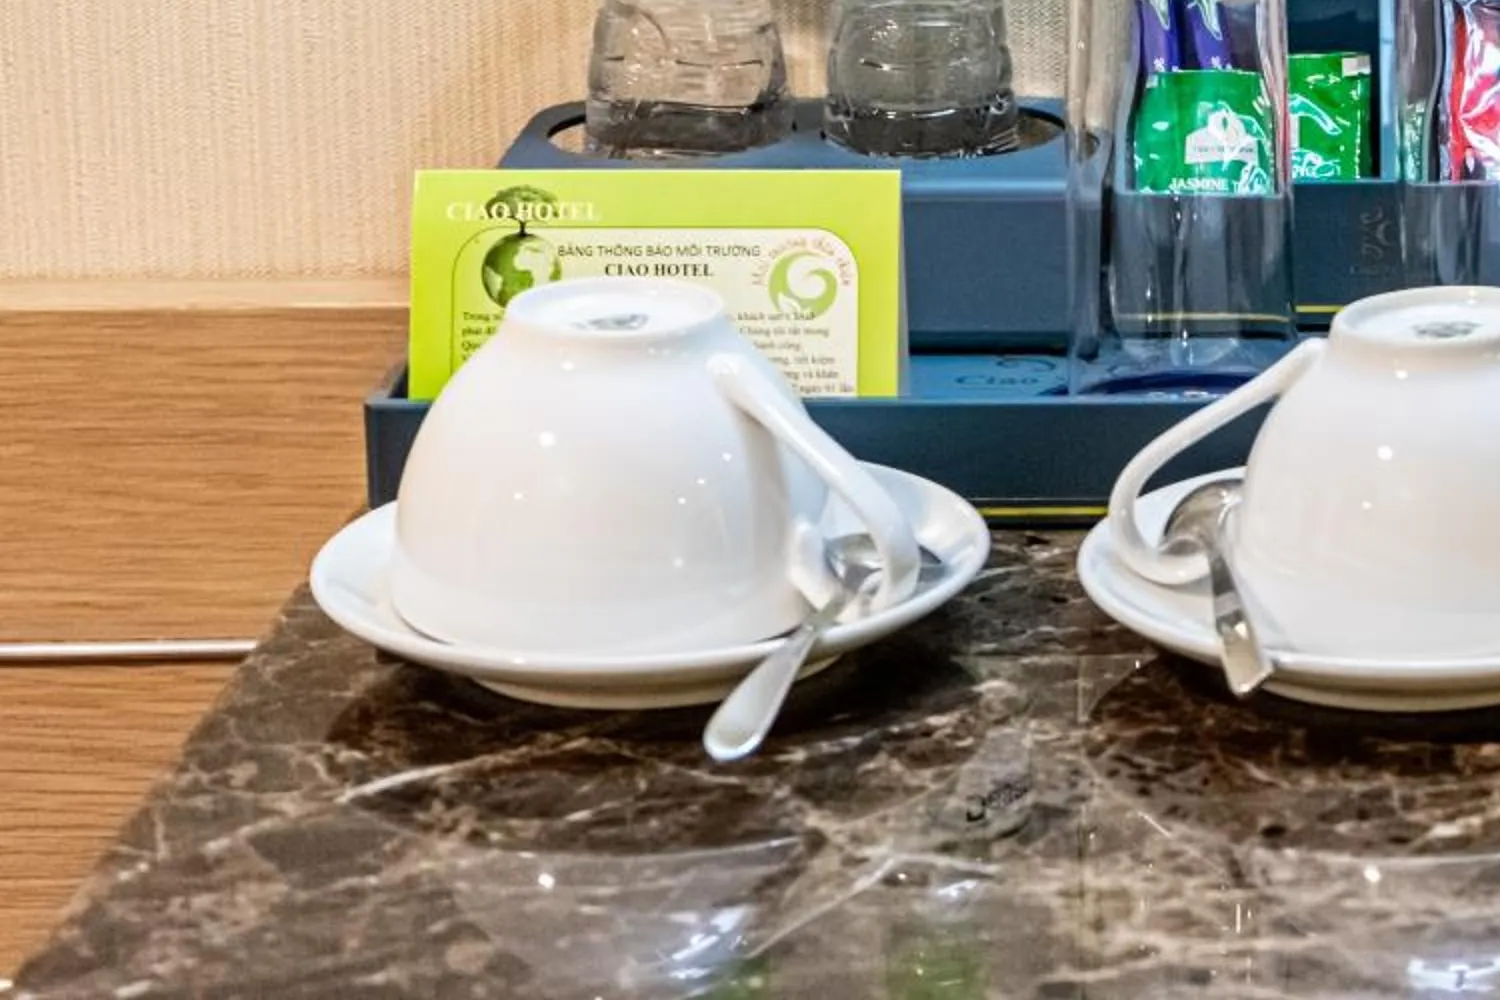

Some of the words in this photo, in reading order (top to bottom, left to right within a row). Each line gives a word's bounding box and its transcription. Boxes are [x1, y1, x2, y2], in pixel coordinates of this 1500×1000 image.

[1168, 177, 1228, 192] JASMINE
[447, 201, 510, 221] CIAO
[516, 200, 602, 221] HOTEL
[605, 263, 649, 277] CIAO
[653, 263, 714, 277] HOTEL
